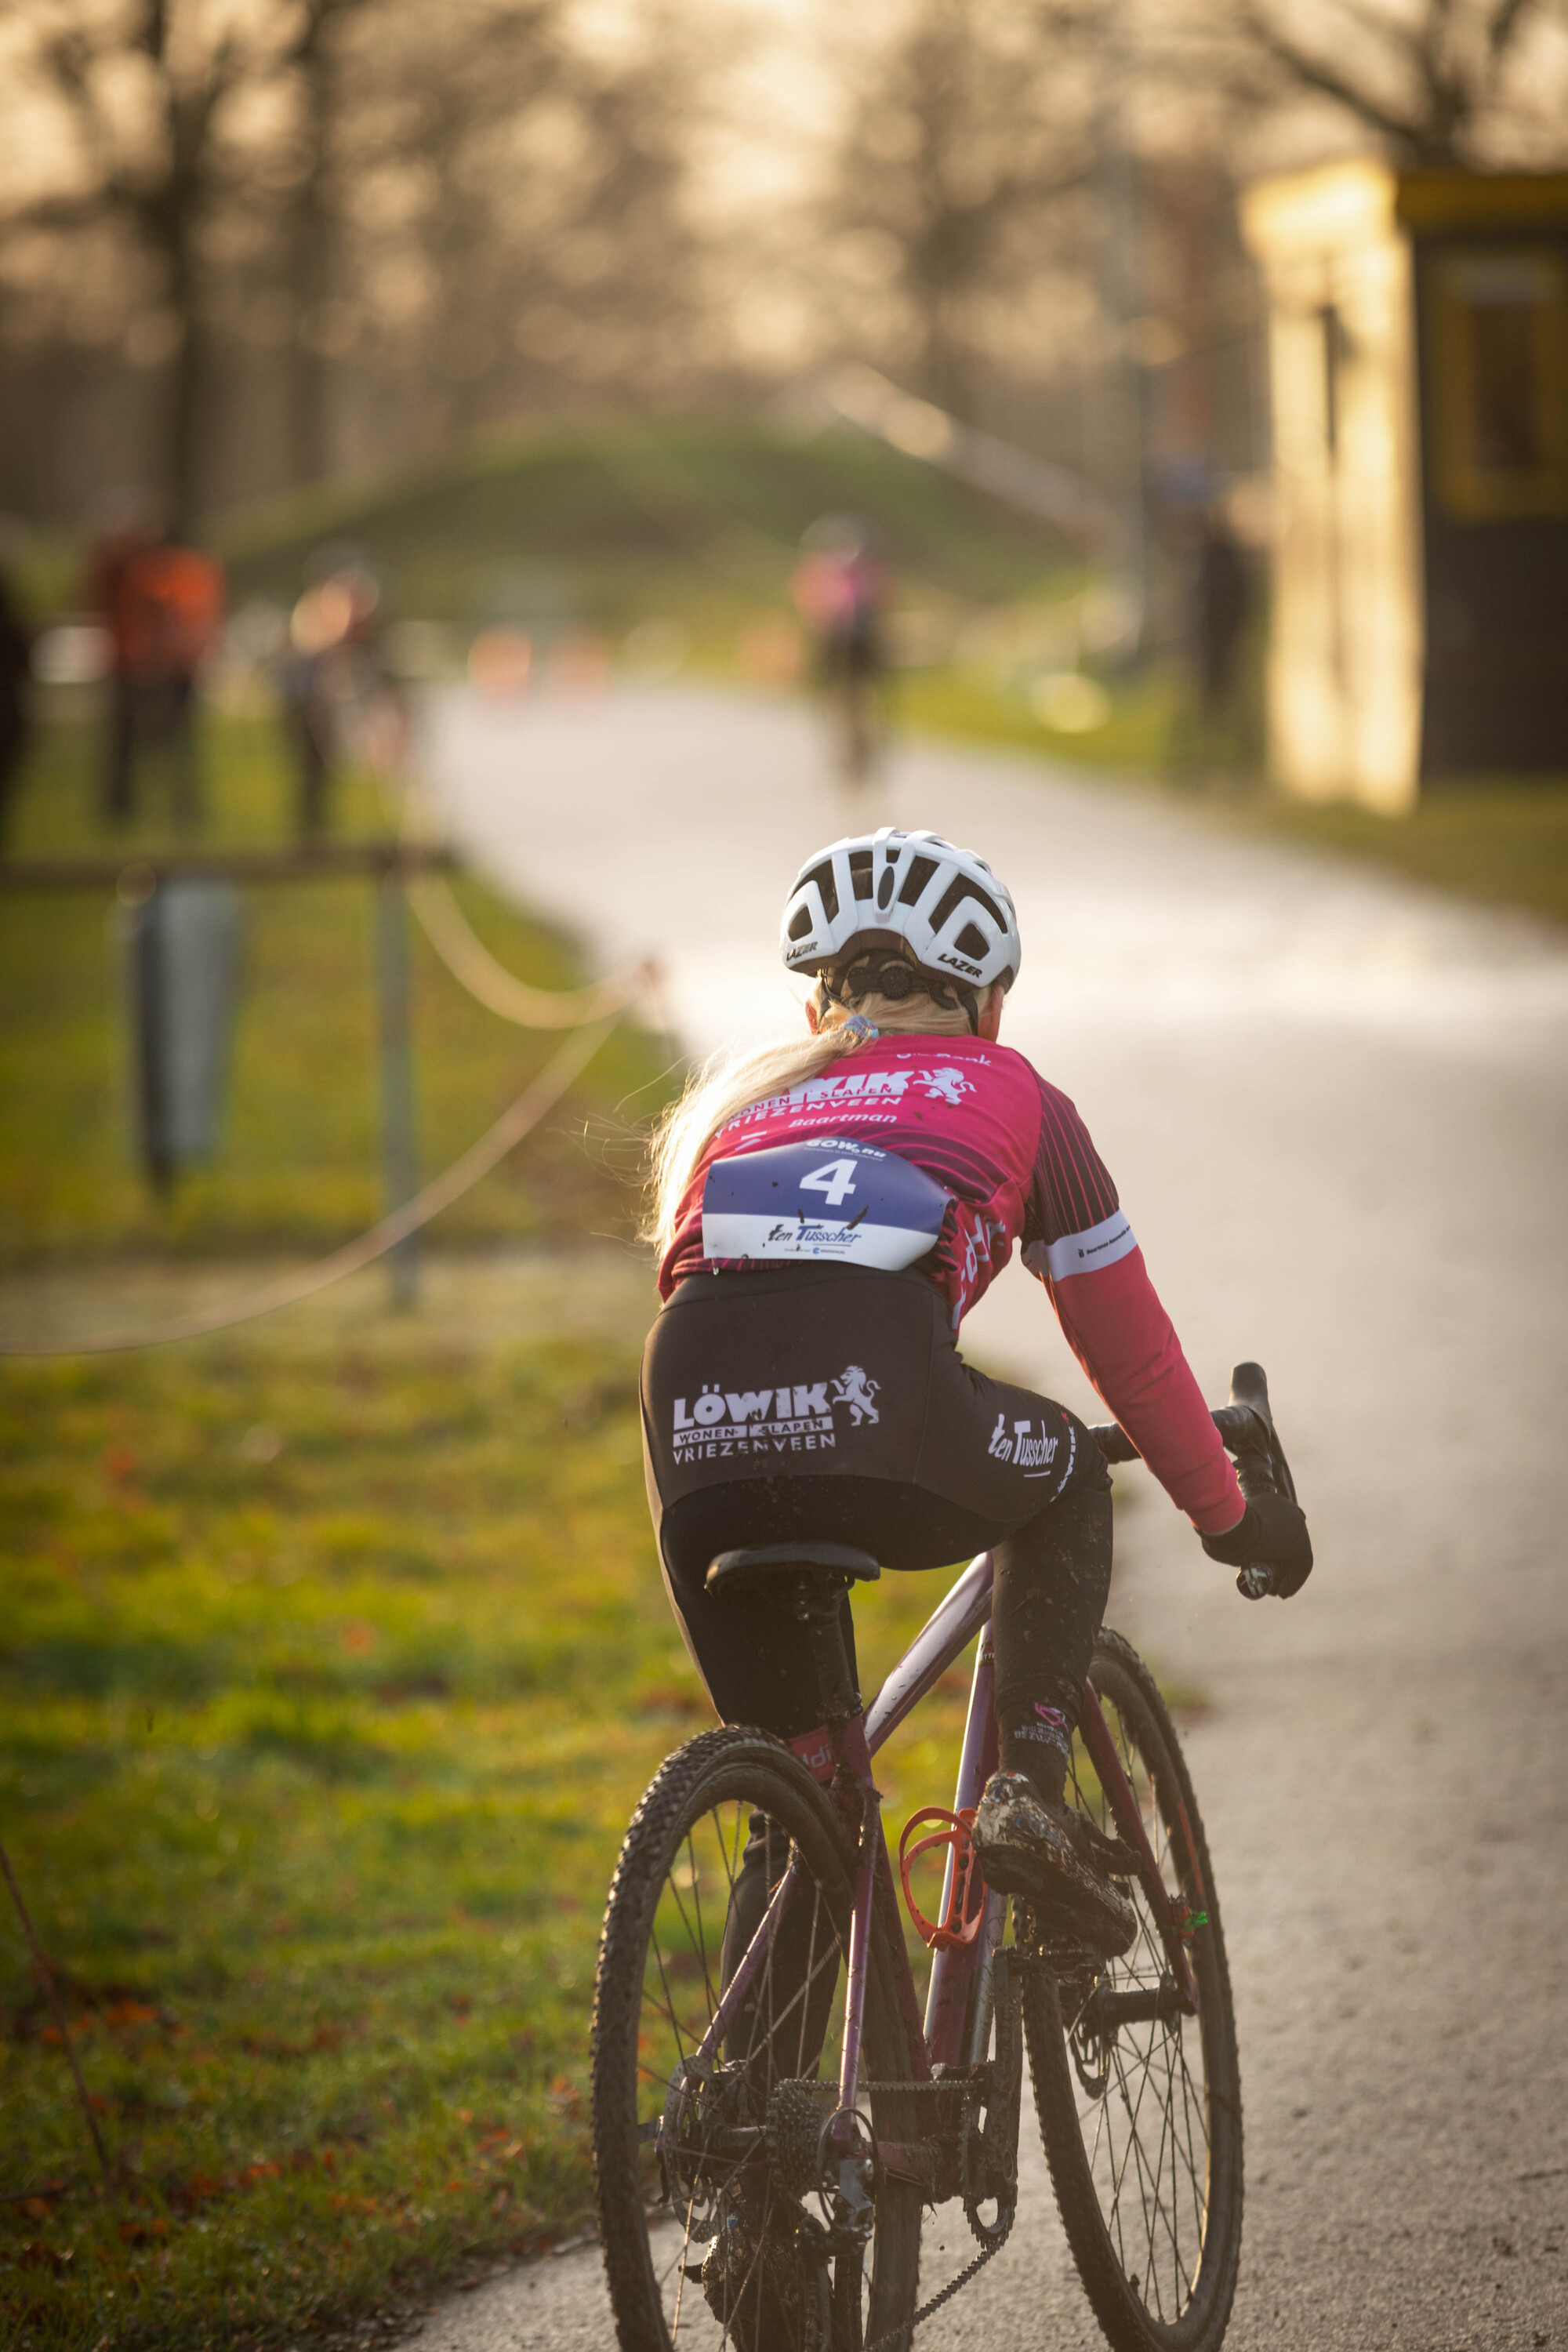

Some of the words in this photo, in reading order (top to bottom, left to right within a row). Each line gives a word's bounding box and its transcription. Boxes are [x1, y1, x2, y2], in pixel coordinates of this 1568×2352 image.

[786, 941, 818, 962] LAZER
[938, 953, 983, 979] LAZER
[714, 1097, 902, 1139] VRIEZENVEEN
[788, 1113, 898, 1128] Baartman
[799, 1158, 858, 1207] 4
[796, 1225, 862, 1243] Tusscher
[673, 1381, 832, 1432] LÖWIK
[679, 1428, 735, 1444] WONEN
[759, 1419, 824, 1435] SLAPEN
[988, 1413, 1013, 1462] ten
[1012, 1420, 1058, 1467] Tusscher
[673, 1433, 837, 1466] VRIEZENVEEN
